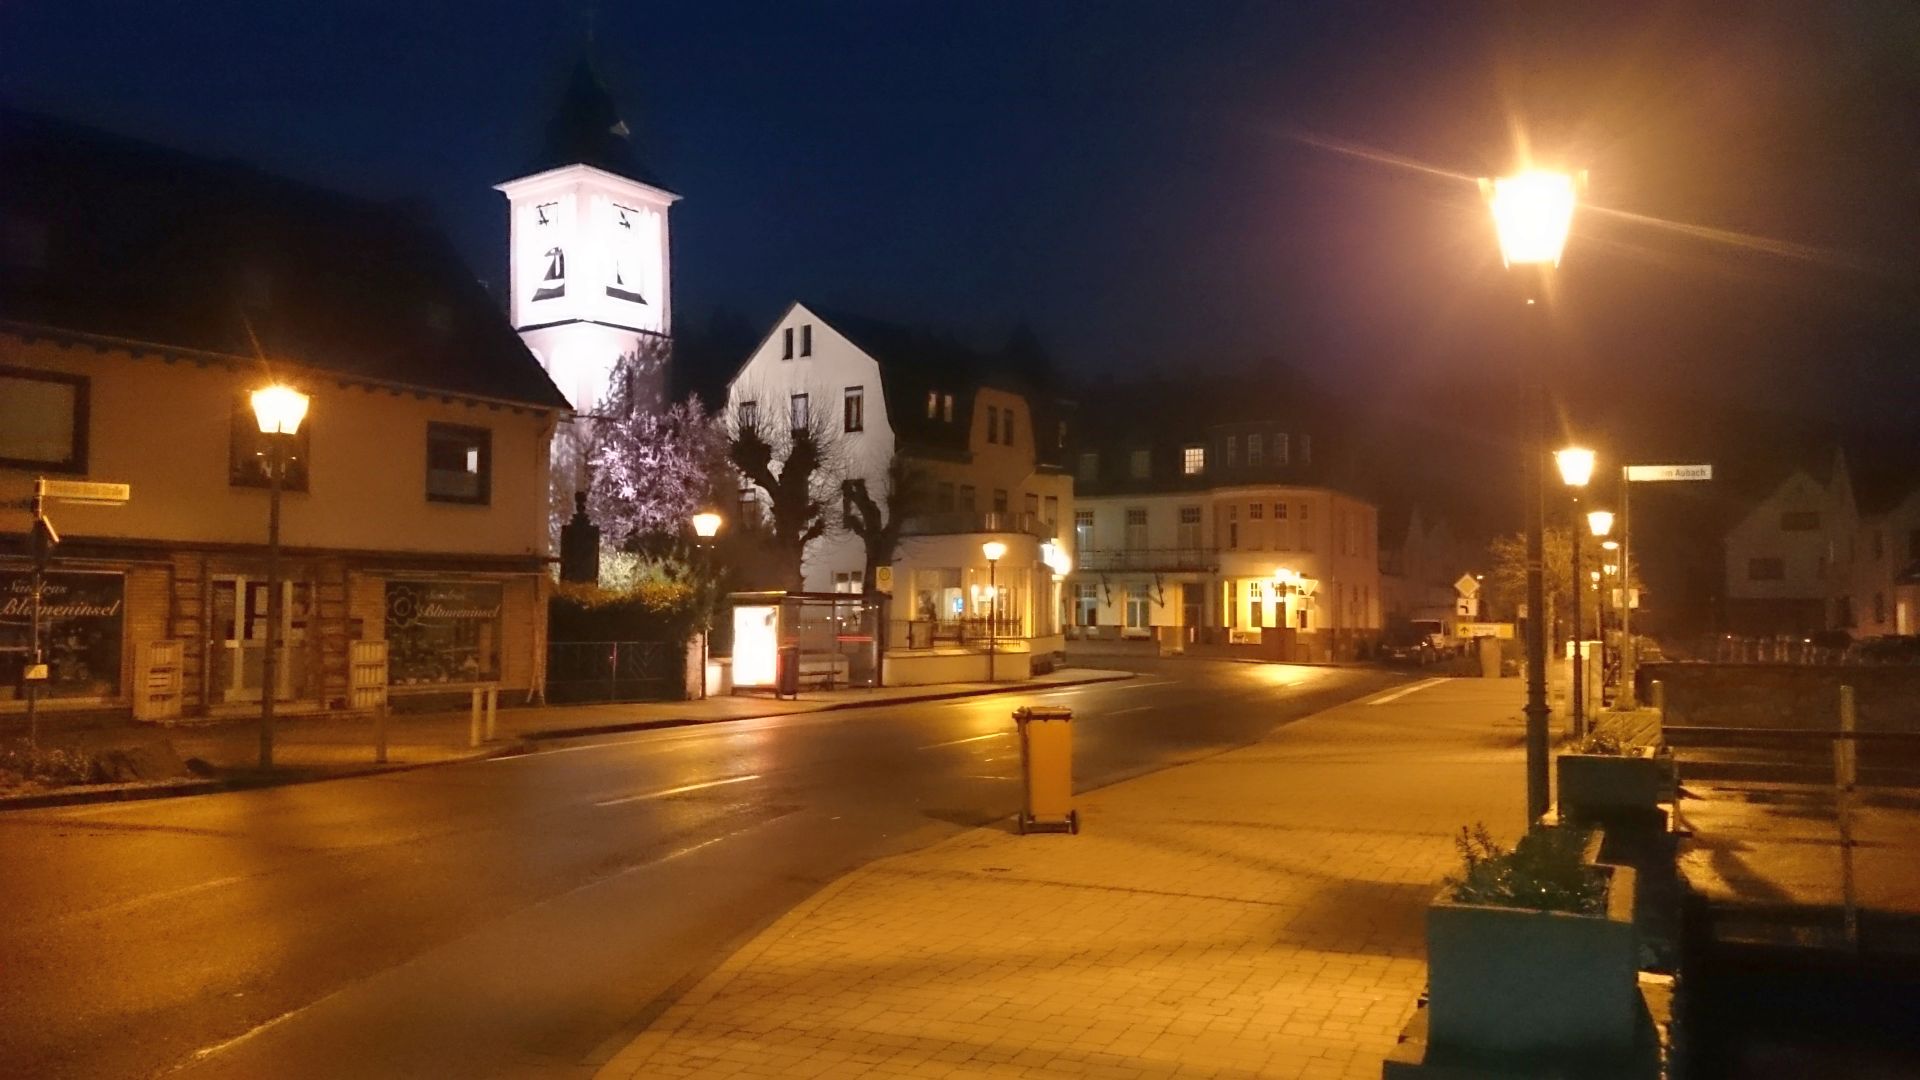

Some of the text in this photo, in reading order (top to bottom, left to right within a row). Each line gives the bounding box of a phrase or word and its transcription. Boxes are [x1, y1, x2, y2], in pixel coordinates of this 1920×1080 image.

[1675, 468, 1706, 477] Aubach
[0, 597, 121, 616] Blumeninsel
[418, 602, 501, 618] Blumeninsel
